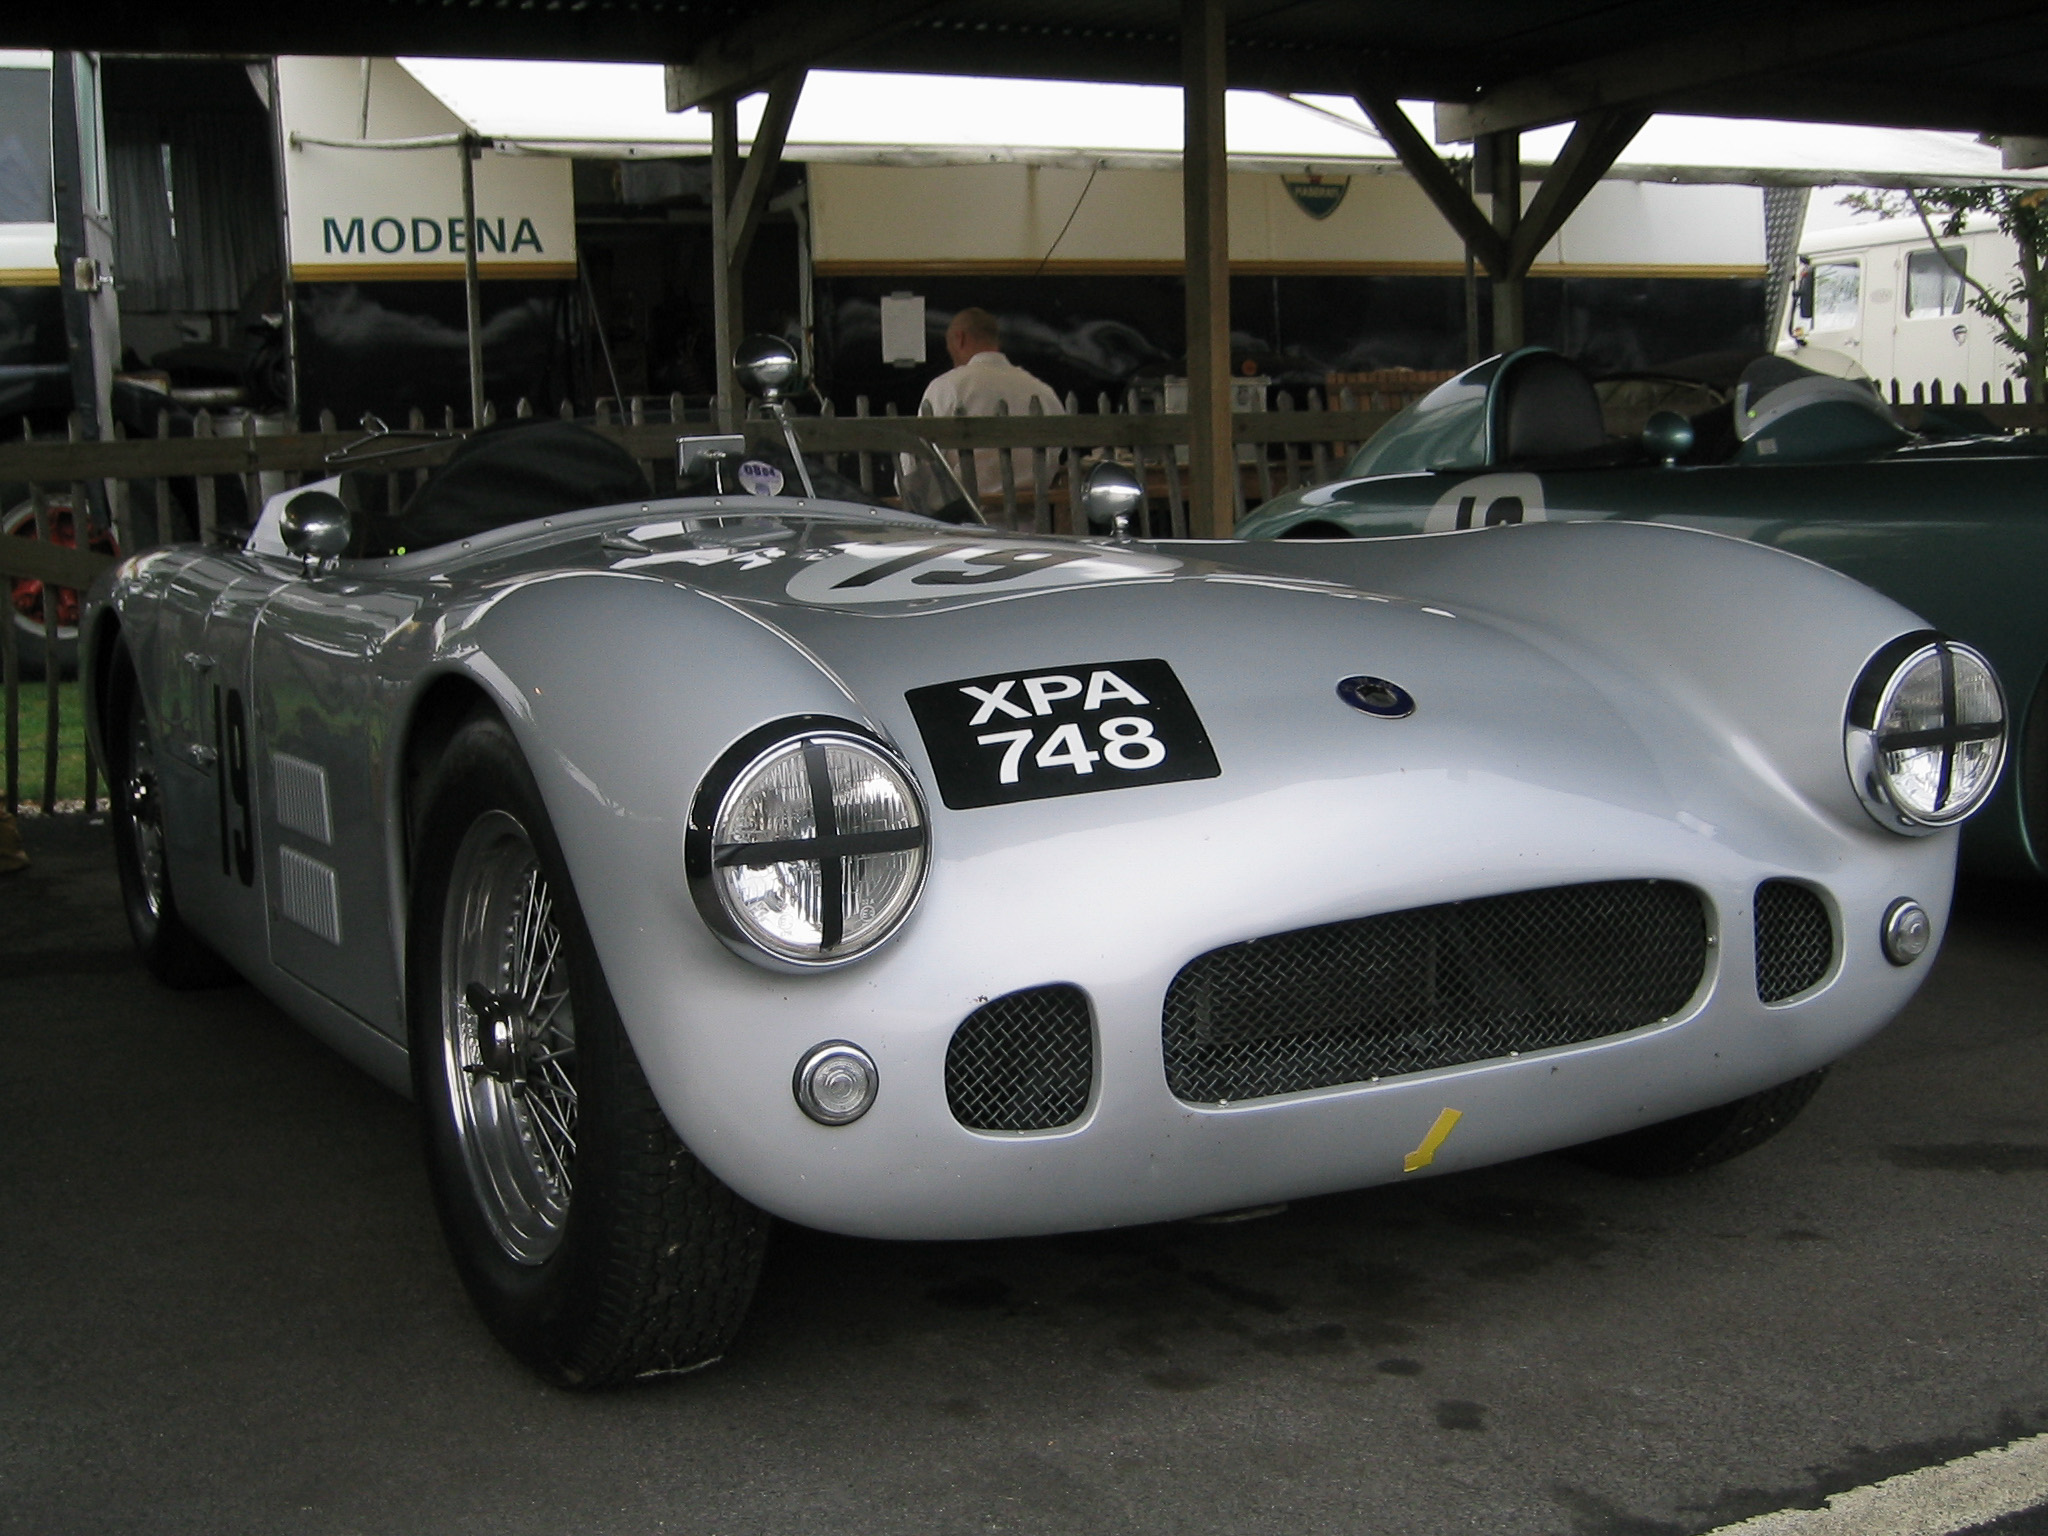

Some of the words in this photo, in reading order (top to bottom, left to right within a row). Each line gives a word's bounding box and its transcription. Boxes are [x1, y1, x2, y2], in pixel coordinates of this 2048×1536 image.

[322, 216, 544, 254] MODENA
[959, 670, 1150, 726] XPA
[977, 716, 1166, 784] 748
[213, 683, 255, 888] 19
